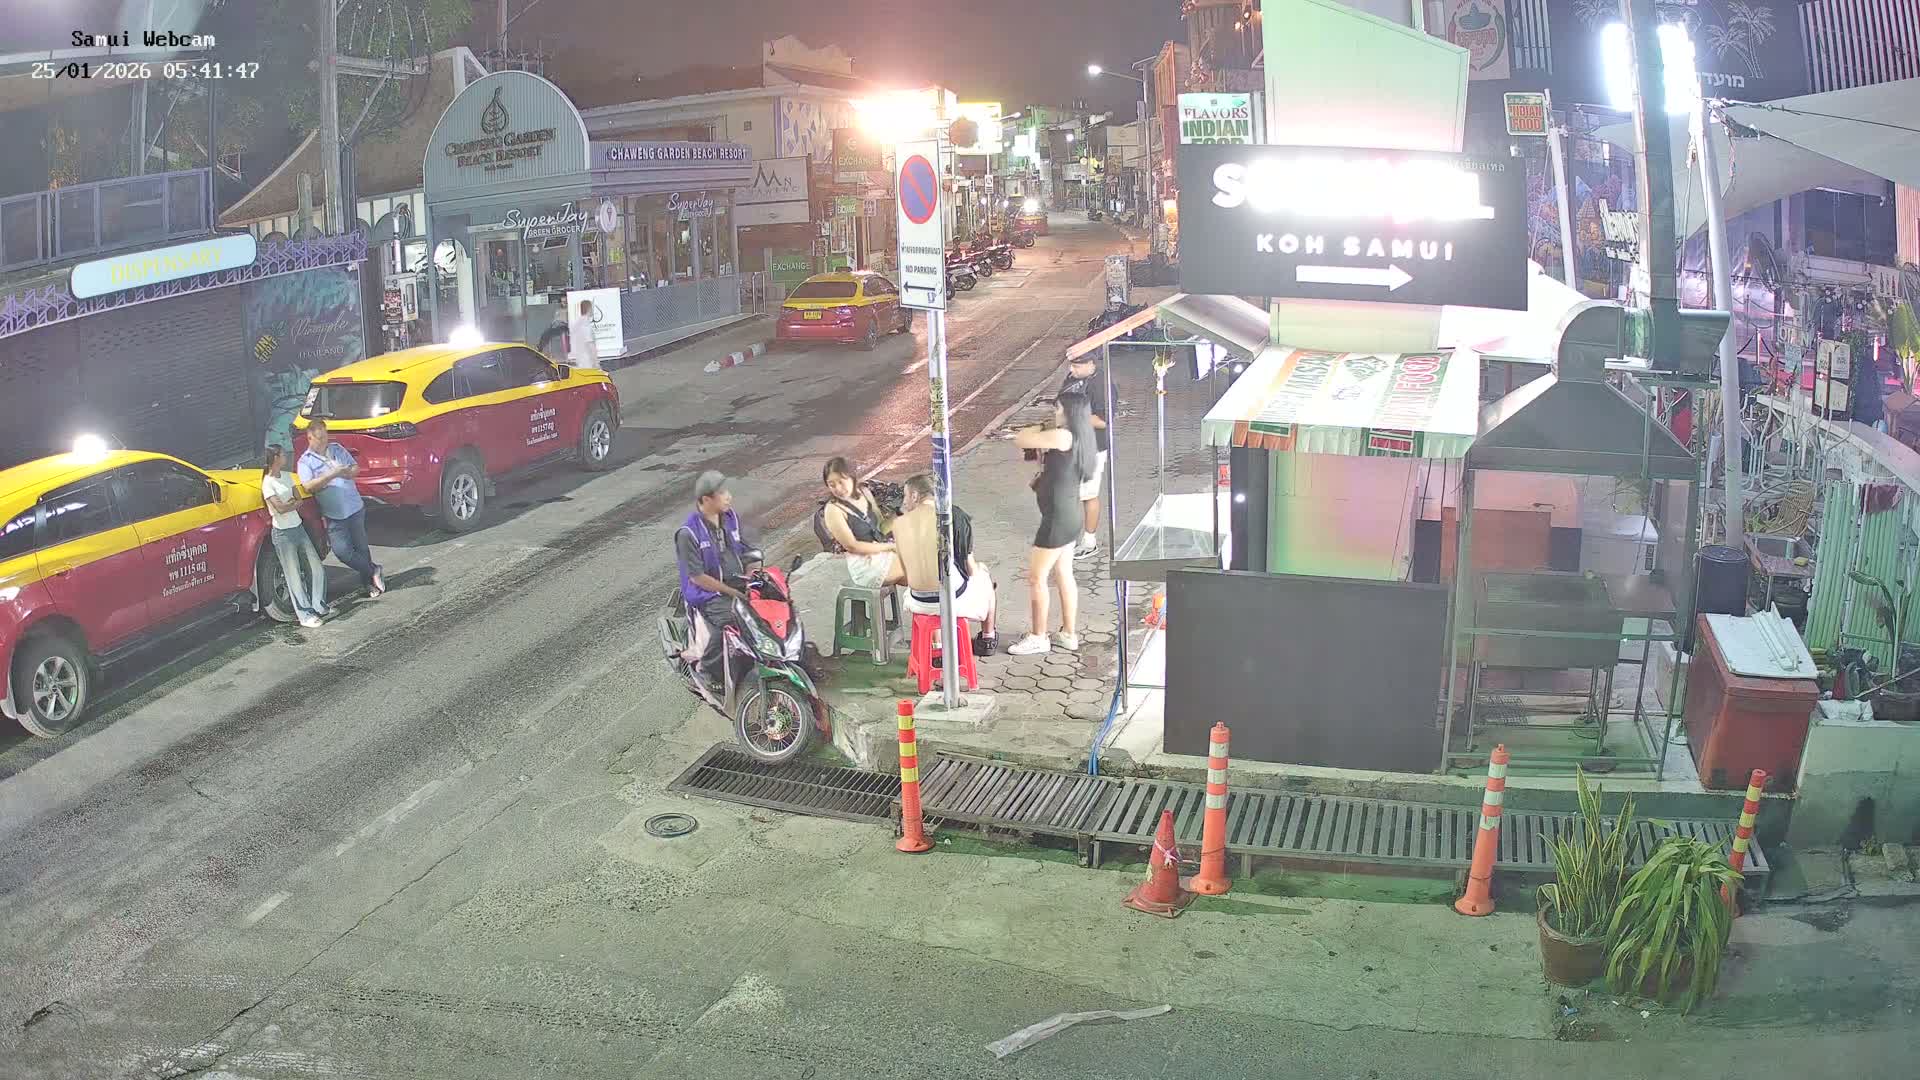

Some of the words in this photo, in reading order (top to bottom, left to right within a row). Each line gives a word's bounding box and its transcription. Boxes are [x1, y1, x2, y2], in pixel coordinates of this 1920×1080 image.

[1184, 107, 1249, 119] FLAVORS
[1508, 105, 1542, 118] INDIAN
[1182, 120, 1249, 137] INDIAN
[1511, 118, 1541, 131] FOOD
[611, 147, 654, 160] CHAWENG
[657, 147, 690, 160] GARDEN
[692, 147, 717, 160] BEACH
[719, 148, 746, 160] RESORT
[502, 202, 588, 240] SuperJay
[528, 227, 550, 238] GREEN
[551, 224, 581, 236] GROCER
[1256, 232, 1325, 255] KOH
[1343, 235, 1454, 261] SAMUI
[110, 245, 224, 286] DISPENSARY
[772, 262, 812, 271] EXCHANGE
[905, 264, 913, 273] NO
[914, 265, 937, 275] PARKING
[165, 538, 208, 565] แท็กซี่บุคคล
[180, 564, 195, 577] 1115
